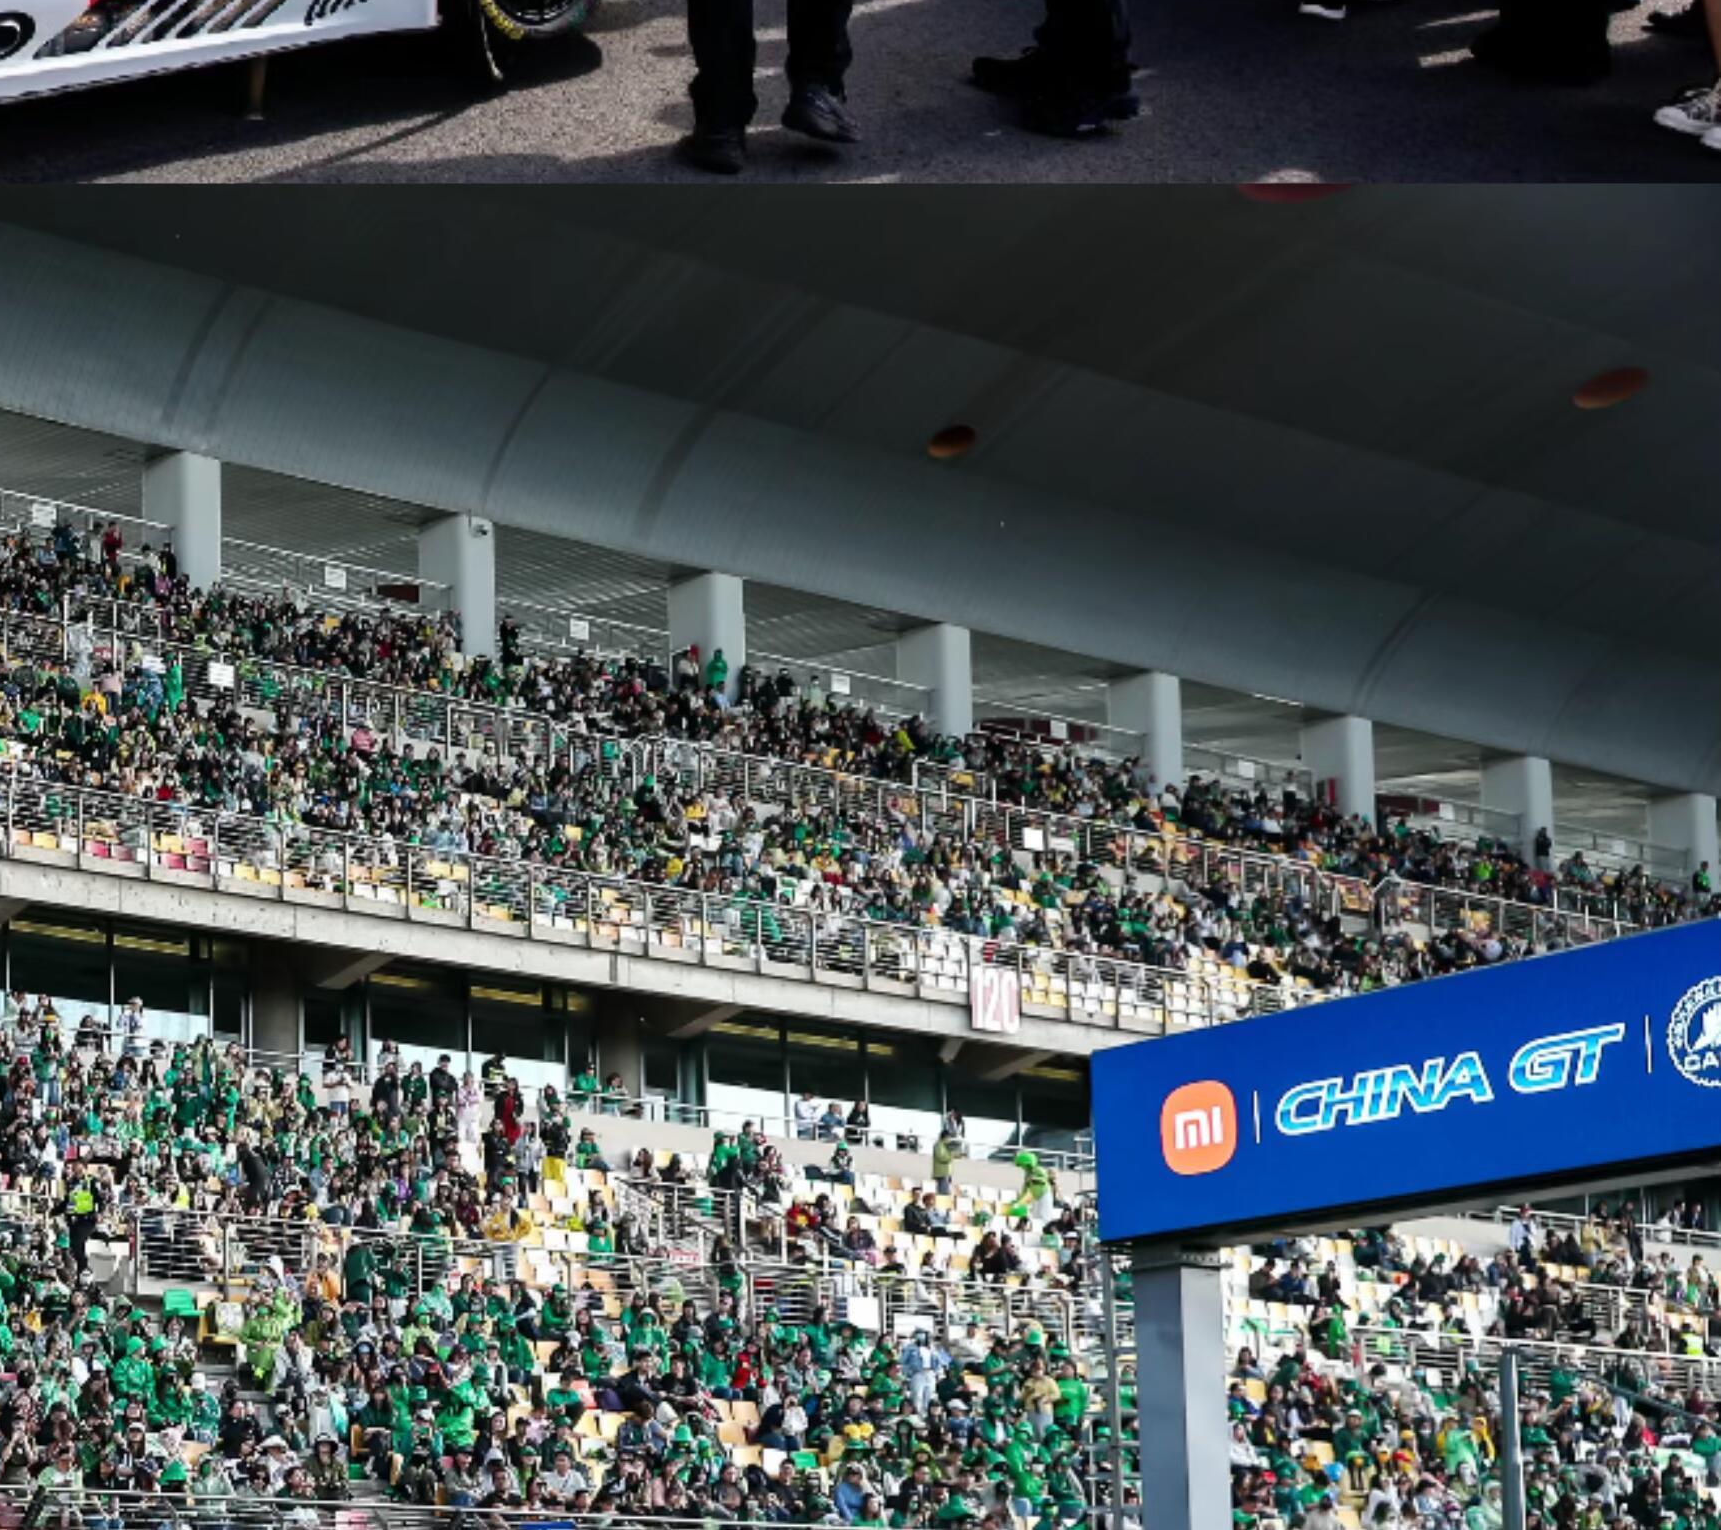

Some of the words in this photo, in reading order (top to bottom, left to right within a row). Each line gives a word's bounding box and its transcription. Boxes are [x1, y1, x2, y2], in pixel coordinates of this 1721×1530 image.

[969, 965, 1021, 1034] 12C
[1275, 1050, 1495, 1136] CHINA
[1507, 1022, 1626, 1094] GT
